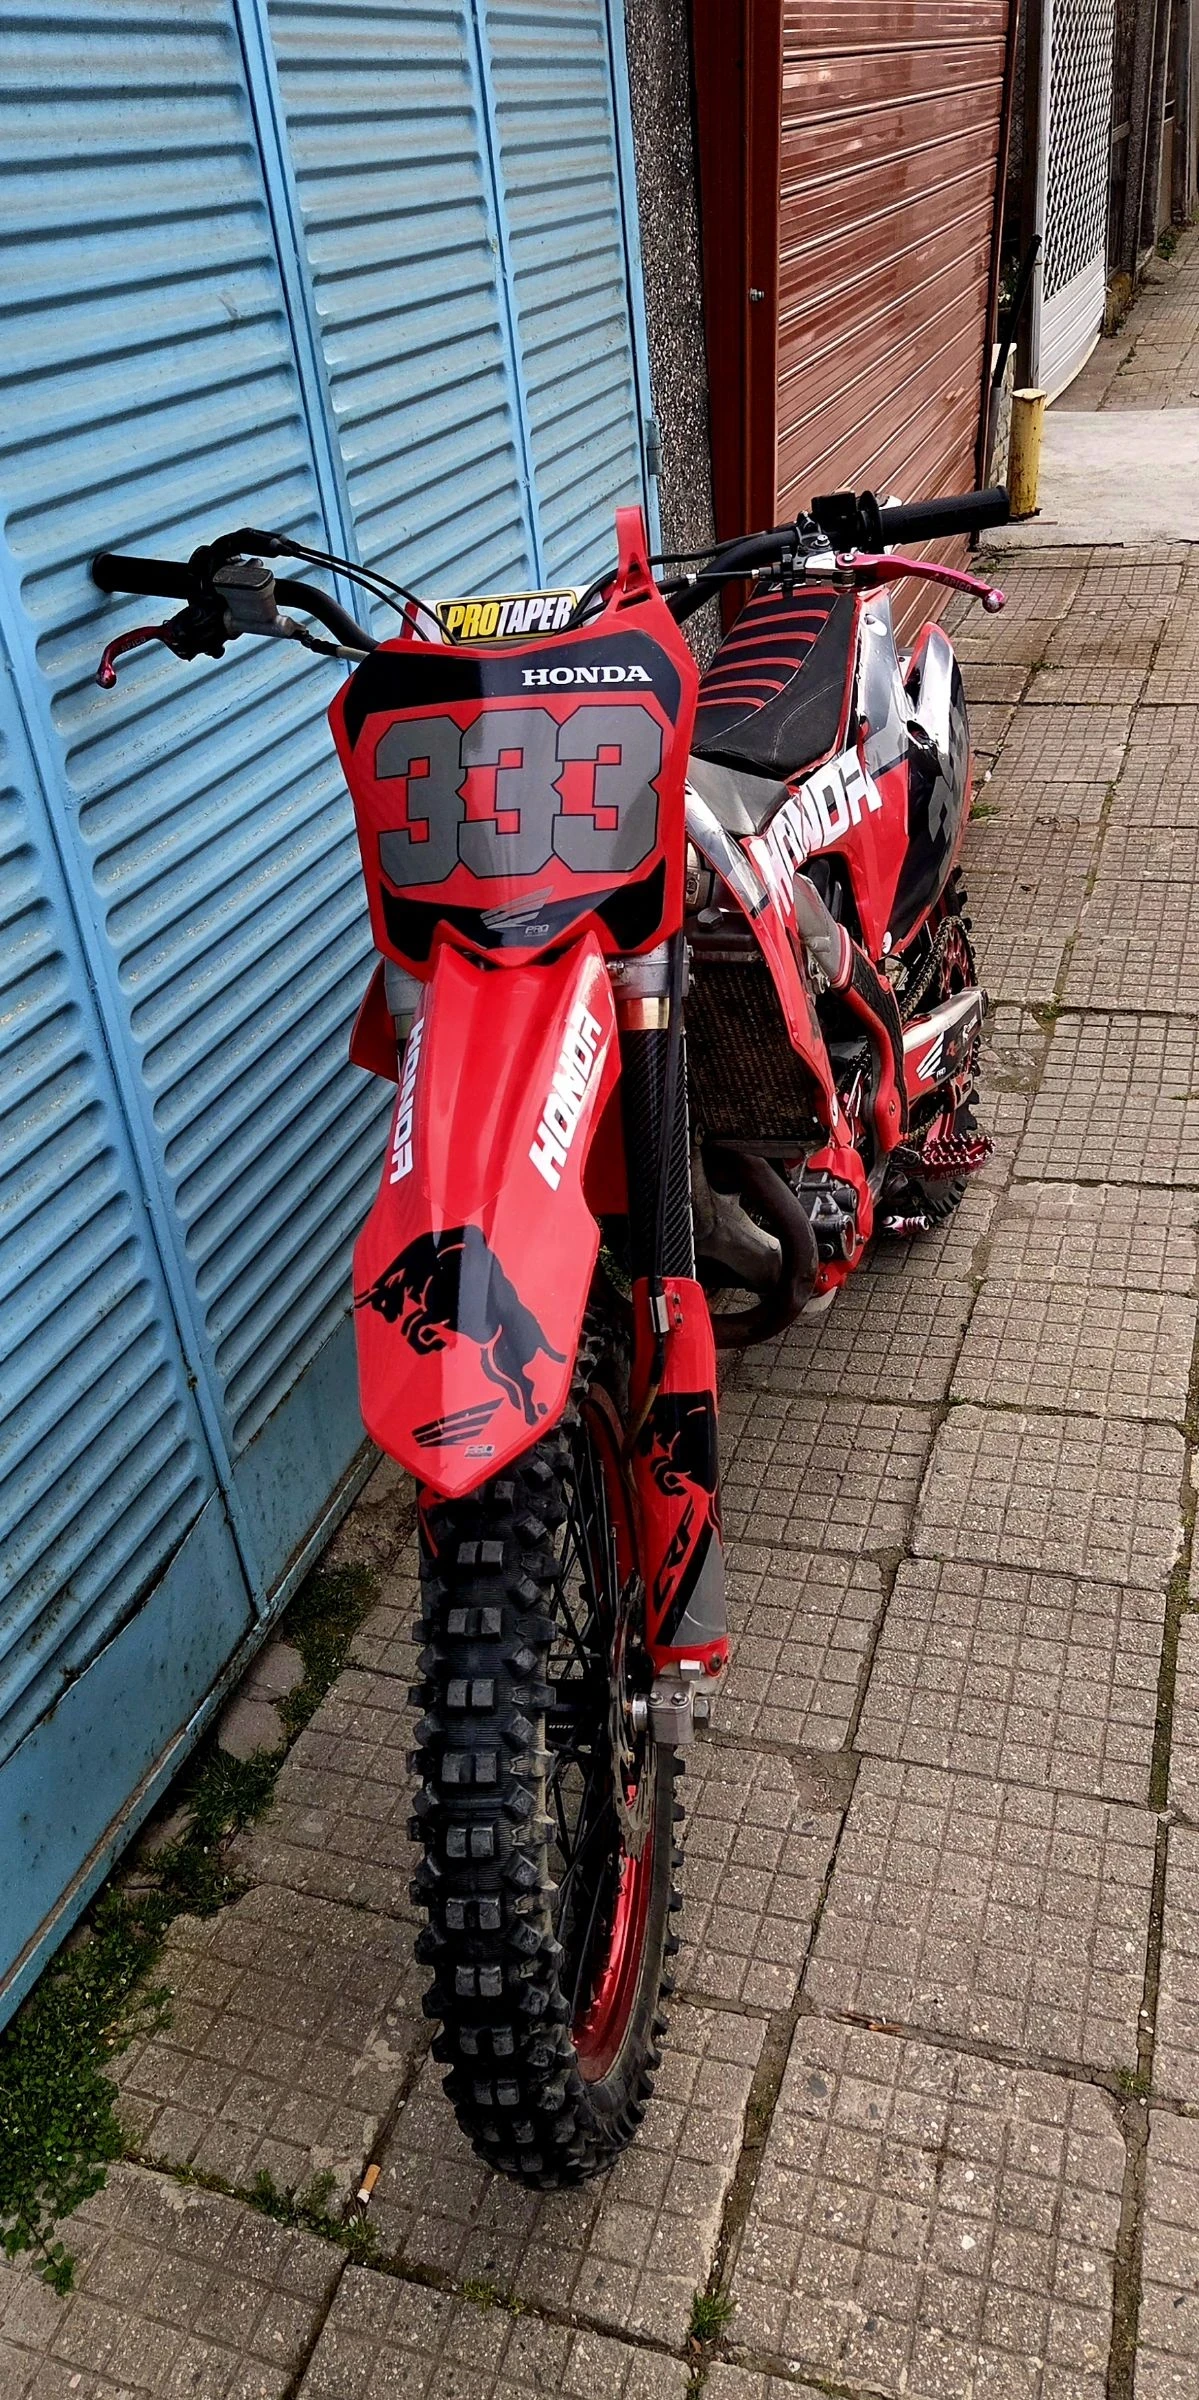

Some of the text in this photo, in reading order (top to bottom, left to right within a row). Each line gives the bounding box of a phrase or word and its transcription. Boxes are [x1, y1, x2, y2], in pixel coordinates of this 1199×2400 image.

[446, 596, 572, 638] PROTAPER
[522, 665, 653, 687] HONDA
[375, 704, 664, 888] 333
[748, 744, 883, 925] HONDA
[525, 924, 549, 934] PRO
[389, 1016, 425, 1185] HONDA
[529, 1000, 603, 1192] HONDA
